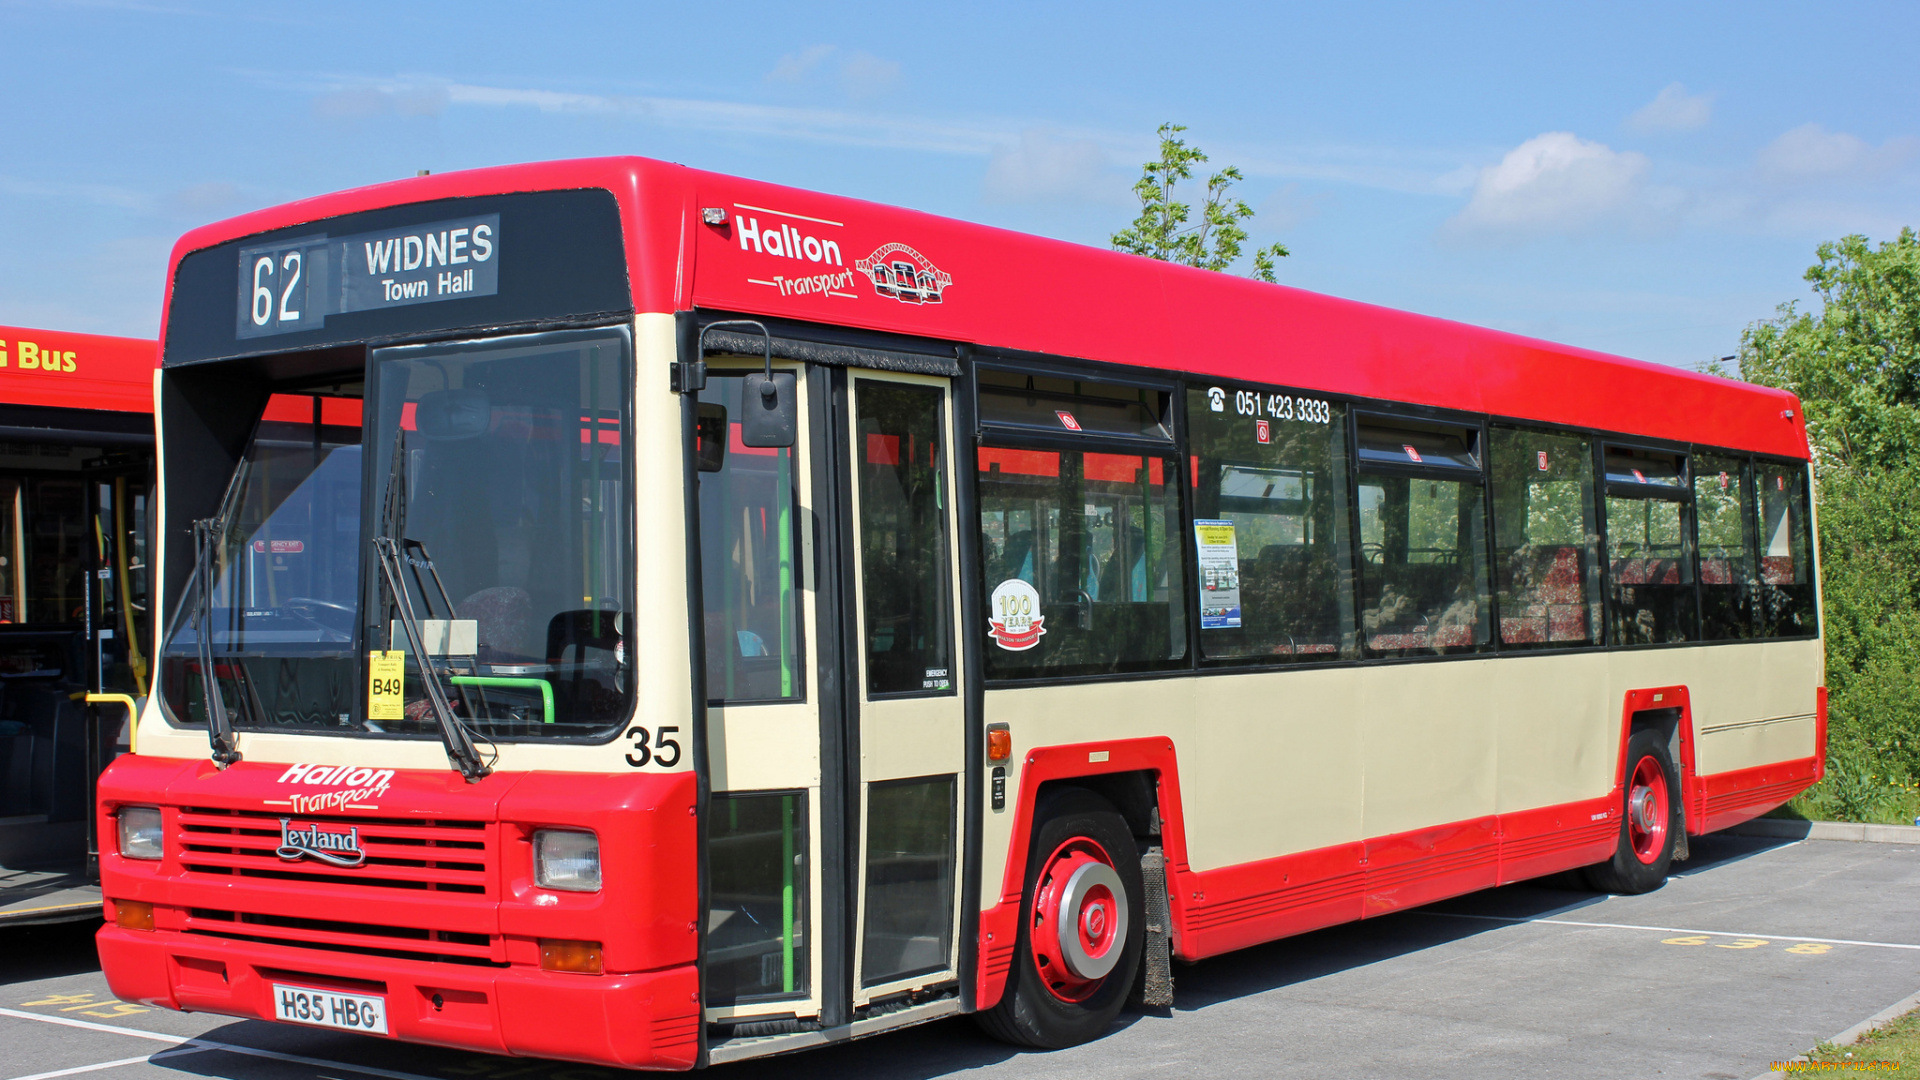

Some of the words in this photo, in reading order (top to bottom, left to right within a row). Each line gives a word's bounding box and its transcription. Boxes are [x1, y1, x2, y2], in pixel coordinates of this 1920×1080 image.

[365, 224, 493, 275] WIDNES
[735, 214, 843, 267] Halton
[252, 251, 300, 326] 62
[382, 279, 428, 301] Town
[438, 269, 474, 295] Hall
[773, 267, 855, 298] Transport
[18, 341, 77, 373] Bus
[1236, 390, 1262, 416] 051
[1267, 394, 1293, 420] 423
[1297, 397, 1330, 424] 3333
[1000, 595, 1031, 616] 100
[1001, 617, 1033, 628] YEARS
[373, 679, 401, 695] B49
[625, 726, 681, 768] 35
[277, 763, 395, 787] Halton
[289, 783, 391, 814] Transport
[277, 818, 363, 860] Leyland
[1660, 935, 1834, 955] 638
[282, 990, 325, 1021] H35
[330, 997, 376, 1028] HBG
